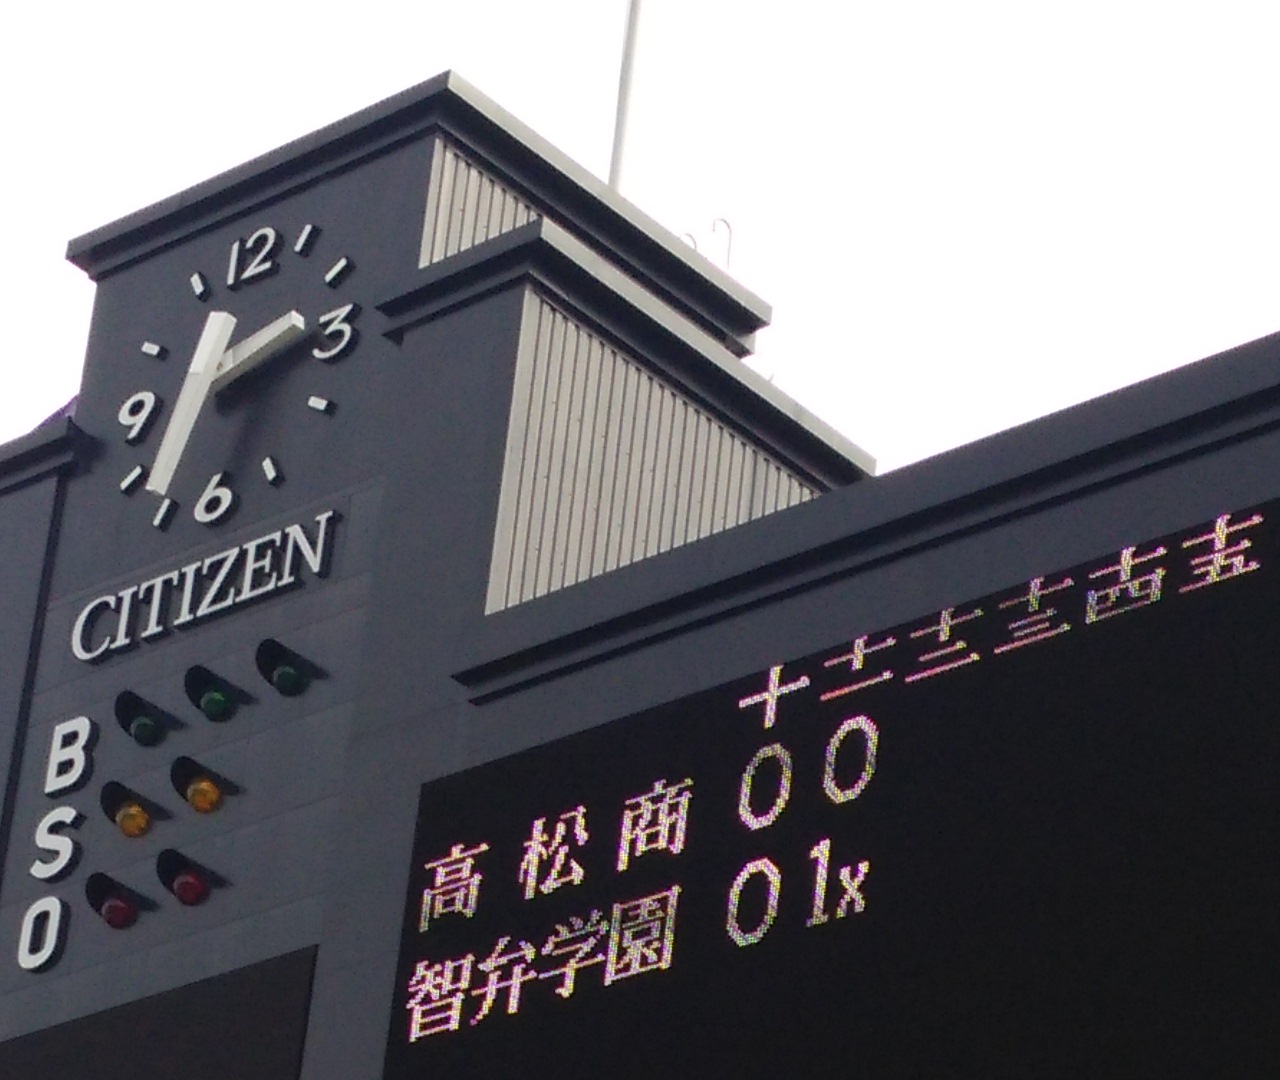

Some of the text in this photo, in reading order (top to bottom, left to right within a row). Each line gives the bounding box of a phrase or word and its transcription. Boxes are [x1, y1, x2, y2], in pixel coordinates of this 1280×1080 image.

[226, 226, 276, 286] 12
[311, 303, 354, 359] 3
[117, 390, 156, 440] 9
[193, 472, 233, 523] 6
[71, 510, 335, 662] CITIZEN
[44, 716, 91, 794] B
[737, 713, 880, 832] 0 0
[29, 806, 77, 879] S
[18, 896, 61, 970] O
[725, 855, 783, 948] 0
[404, 883, 683, 1044] 智弁学園
